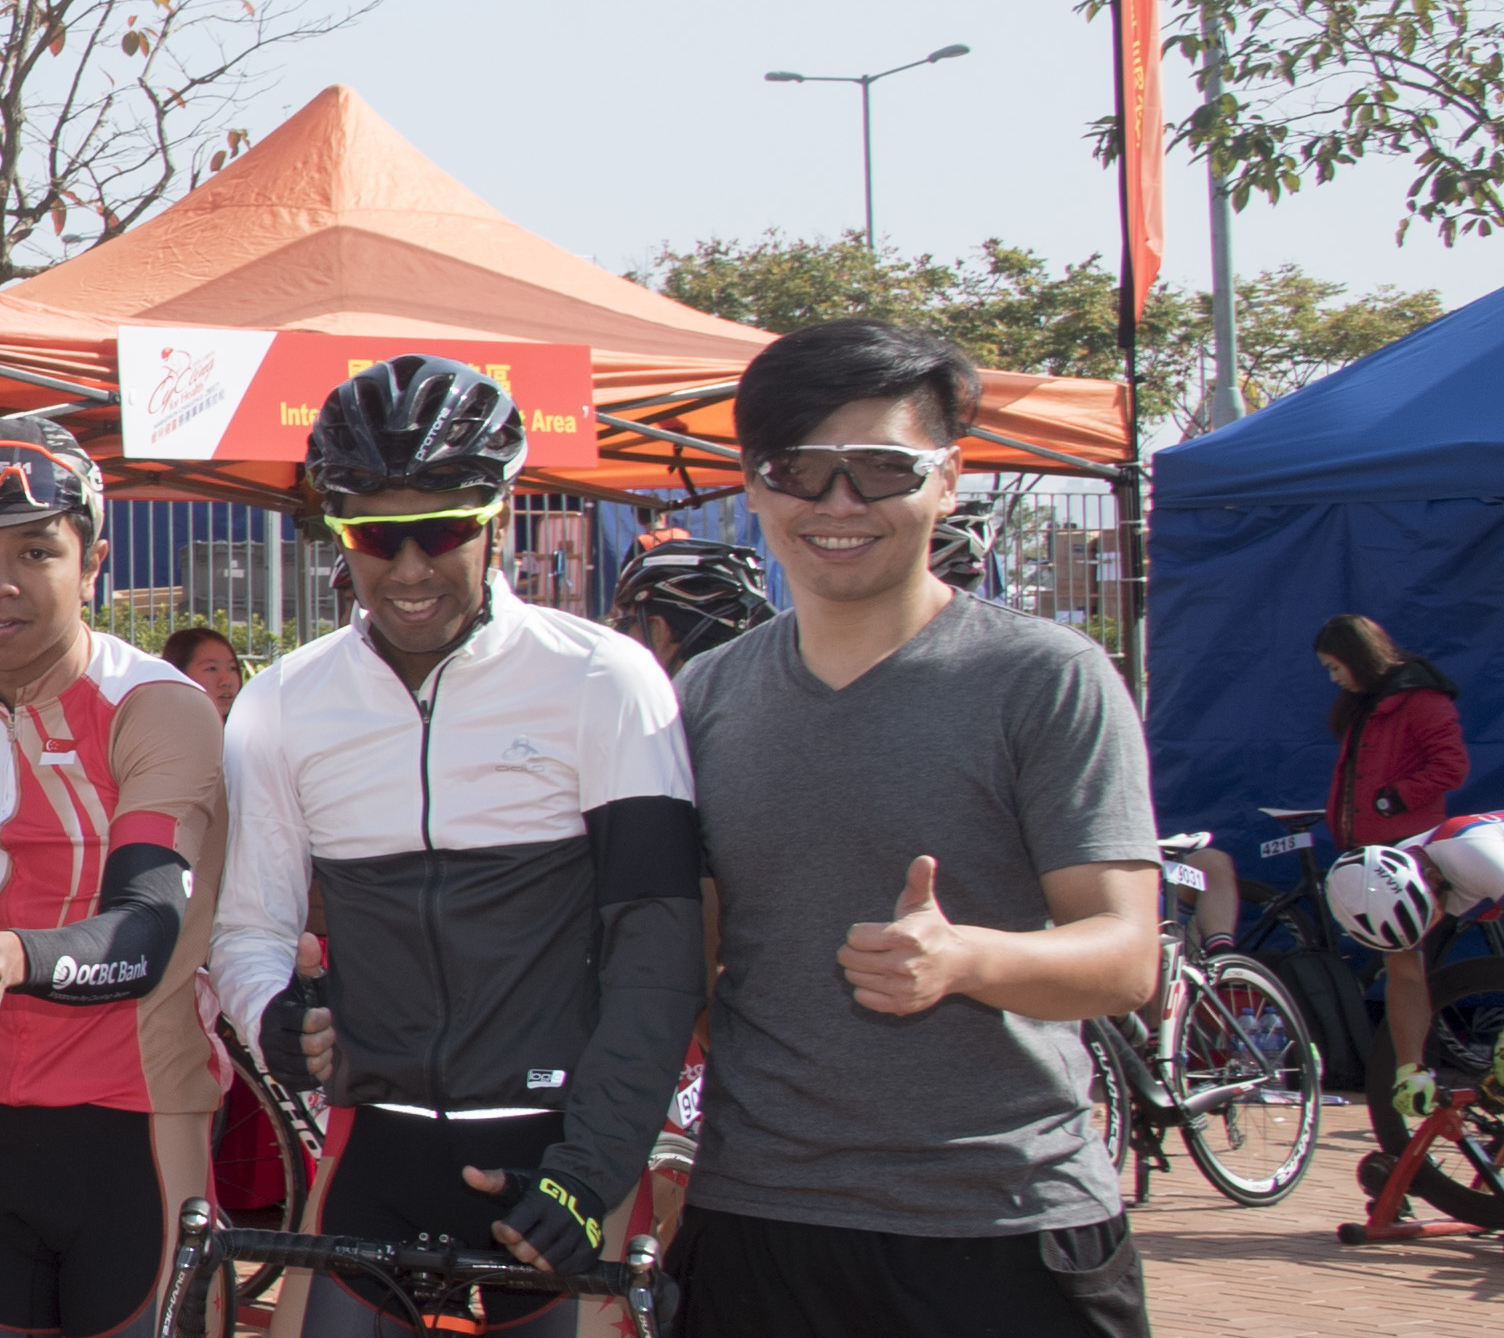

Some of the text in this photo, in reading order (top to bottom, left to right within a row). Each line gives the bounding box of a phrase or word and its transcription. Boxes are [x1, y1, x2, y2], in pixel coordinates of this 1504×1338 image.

[531, 409, 577, 433] Area
[76, 954, 149, 986] OCBC Bank
[162, 1271, 186, 1338] DURA-ACE
